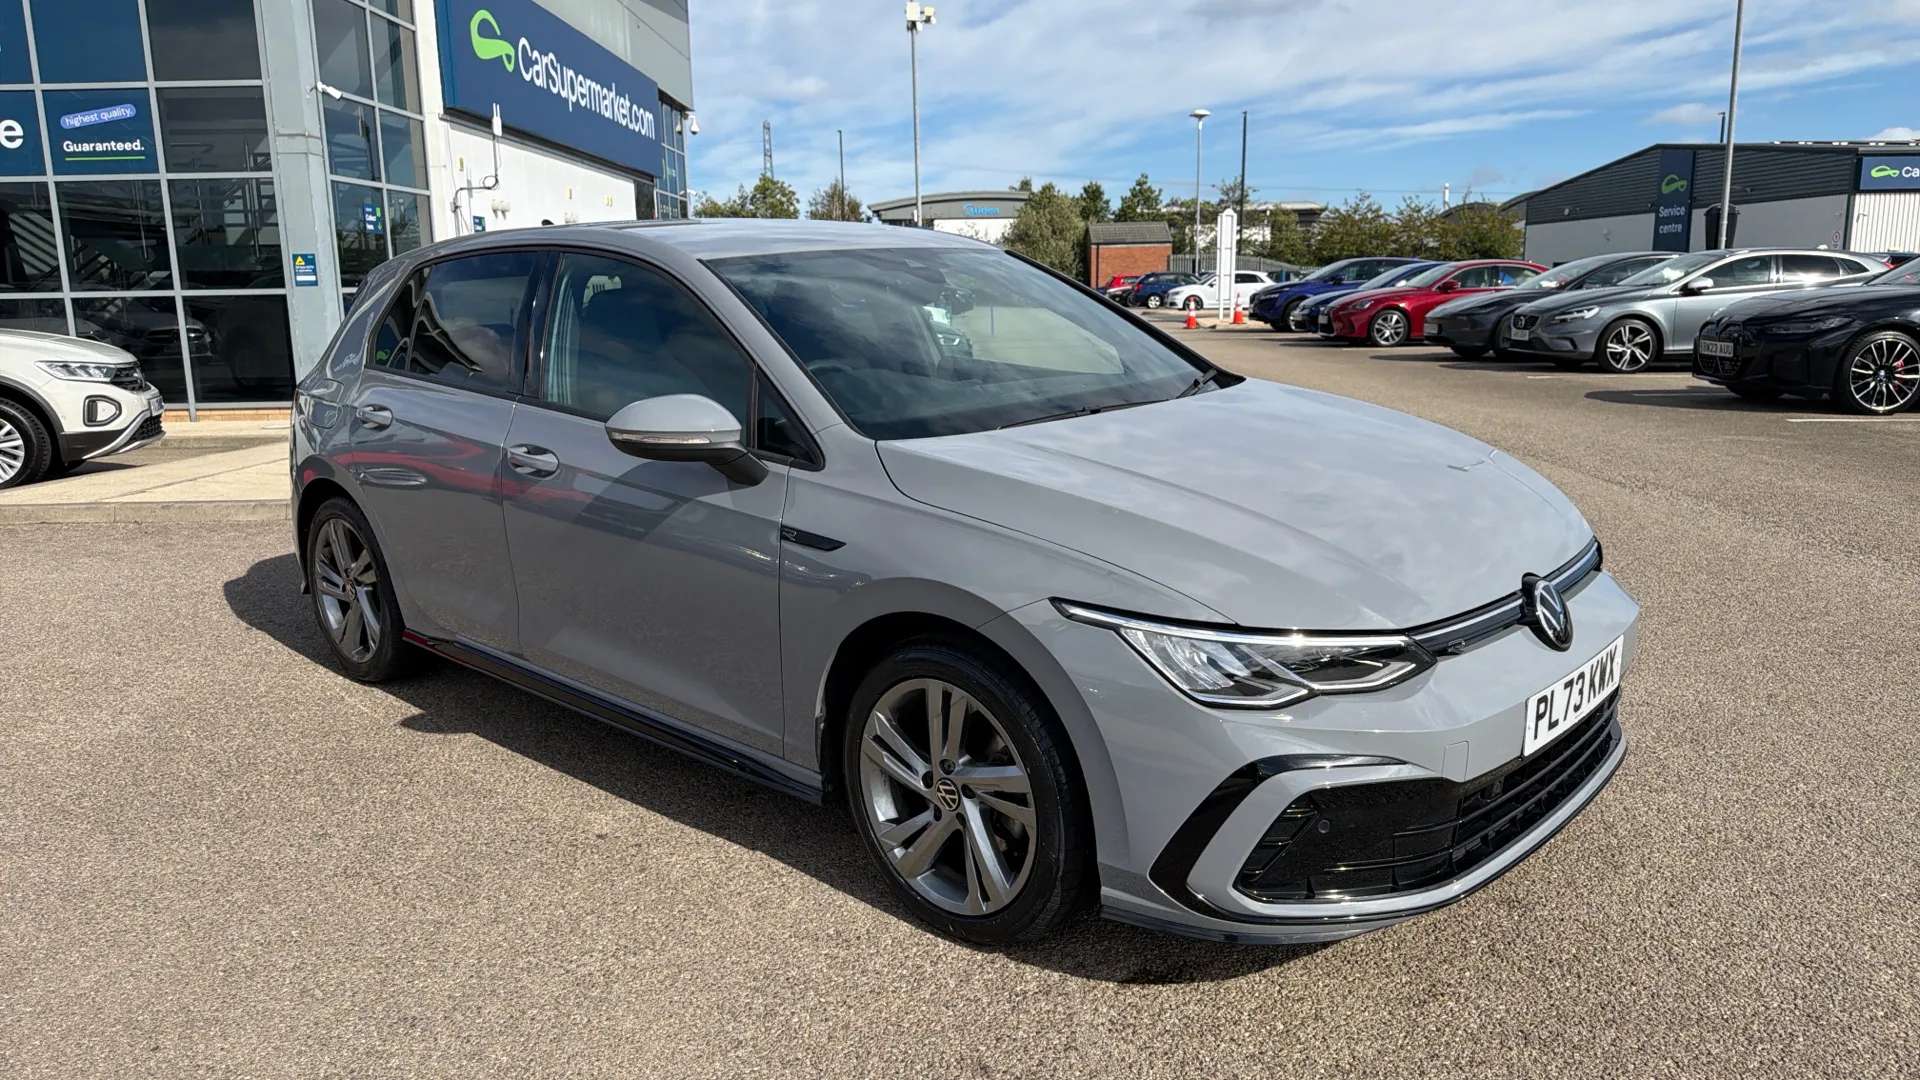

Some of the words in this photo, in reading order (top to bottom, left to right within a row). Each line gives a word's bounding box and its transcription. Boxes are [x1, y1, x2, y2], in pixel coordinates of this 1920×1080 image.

[517, 36, 656, 141] CarSupermarket.com
[64, 112, 99, 127] highest
[100, 106, 133, 121] quality.
[62, 139, 145, 152] Guaranteed.
[1658, 204, 1686, 218] Service
[1658, 223, 1683, 234] centre
[1533, 671, 1586, 741] PL73
[1587, 645, 1618, 703] KWX
